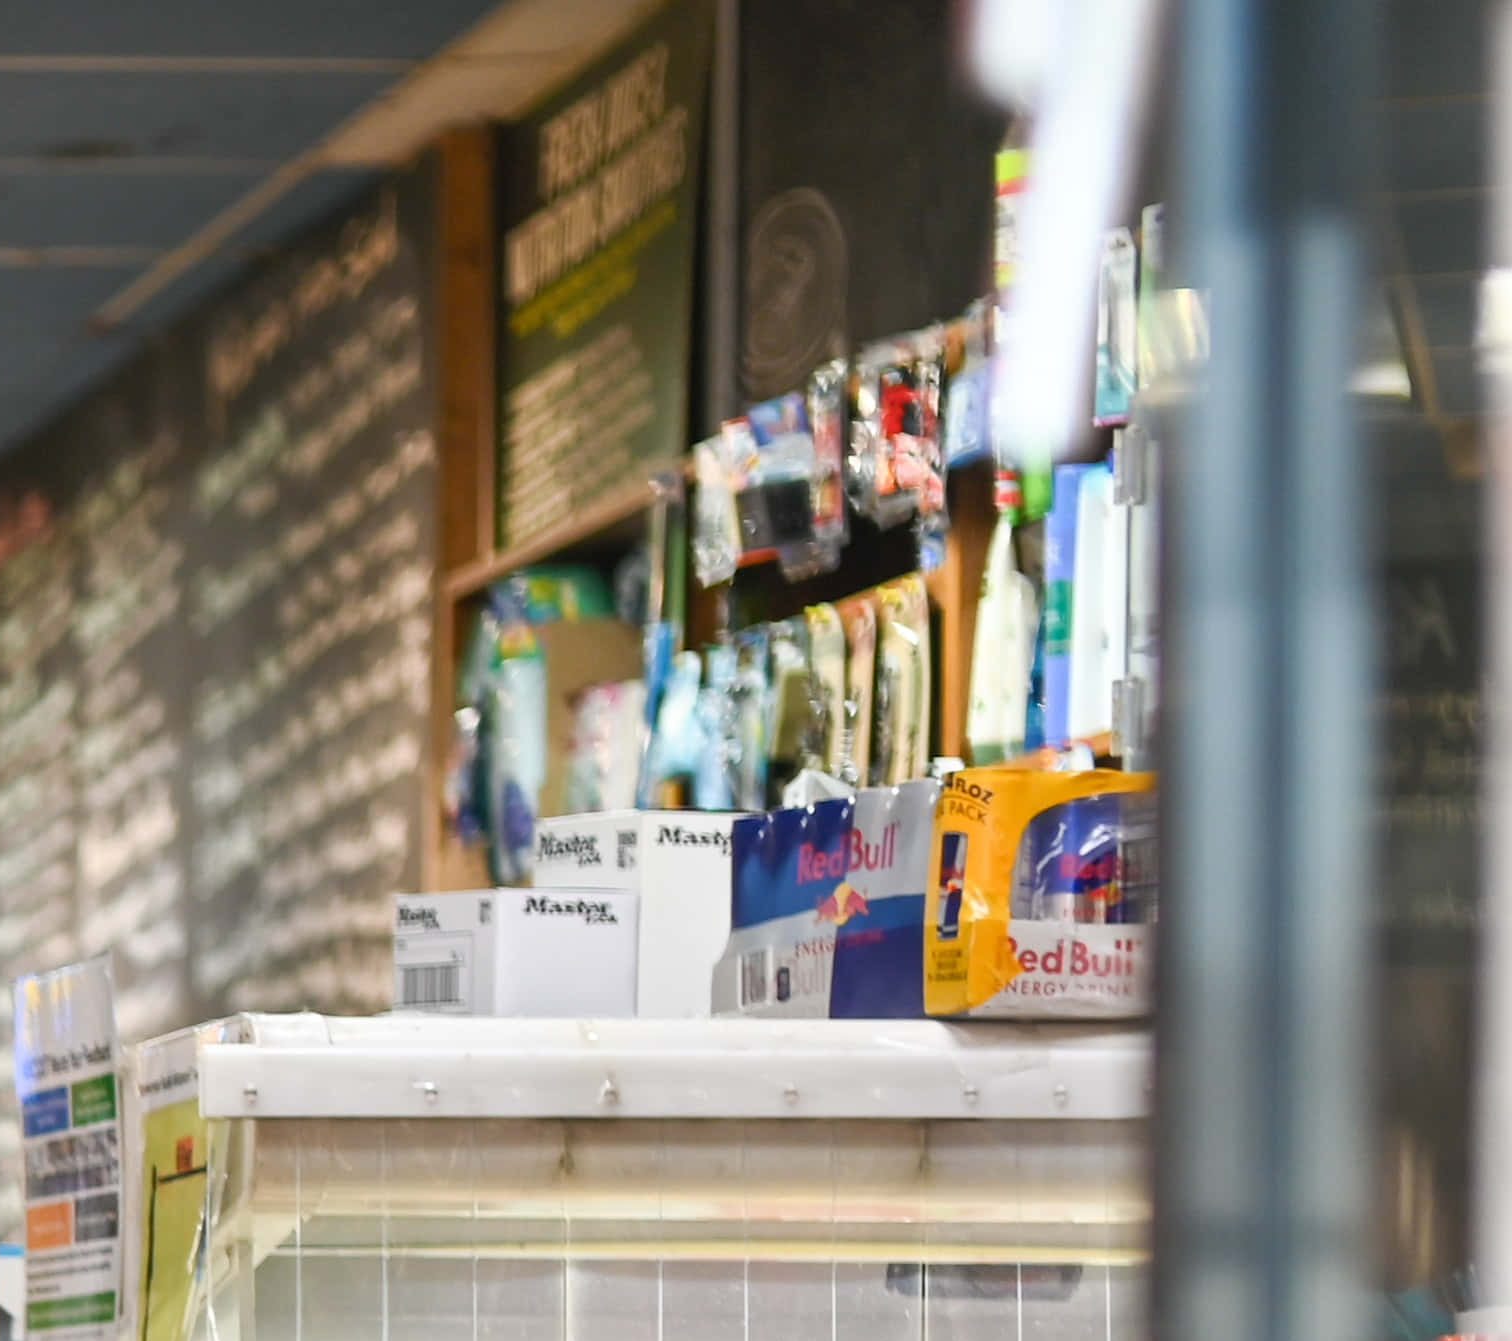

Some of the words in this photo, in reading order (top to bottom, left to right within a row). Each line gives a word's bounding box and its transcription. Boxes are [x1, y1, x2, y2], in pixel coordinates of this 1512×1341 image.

[796, 840, 846, 885] Red
[850, 823, 898, 870] Bull
[1070, 940, 1135, 979] Bull
